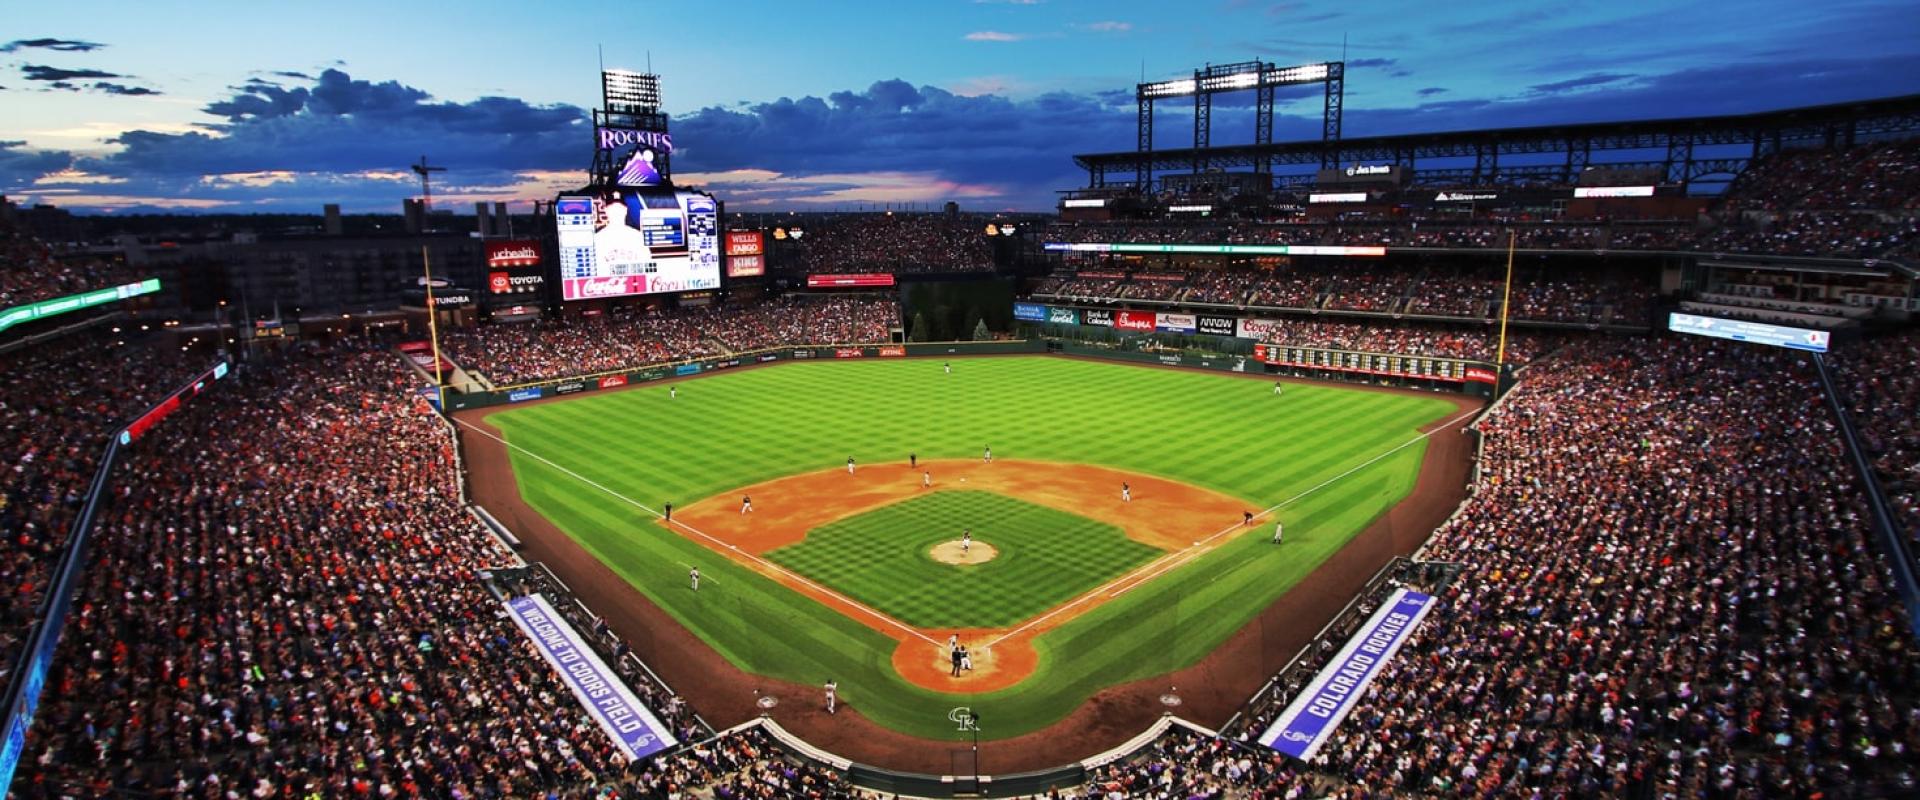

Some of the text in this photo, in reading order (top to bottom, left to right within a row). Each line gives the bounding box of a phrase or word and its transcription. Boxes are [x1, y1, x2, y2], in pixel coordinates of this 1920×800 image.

[600, 129, 673, 152] ROCKIES
[731, 234, 757, 243] WELLS
[732, 243, 759, 252] FARGO
[493, 246, 535, 260] uchealth
[509, 275, 544, 285] TOYOTA
[435, 295, 470, 305] TUNDRA
[1087, 310, 1102, 318] Bank
[1087, 317, 1114, 326] Colorado
[1200, 318, 1233, 328] ARROW
[1308, 611, 1409, 718] COLORADO ROCKIES
[522, 607, 642, 734] WELCOME TO COORS FIELD
